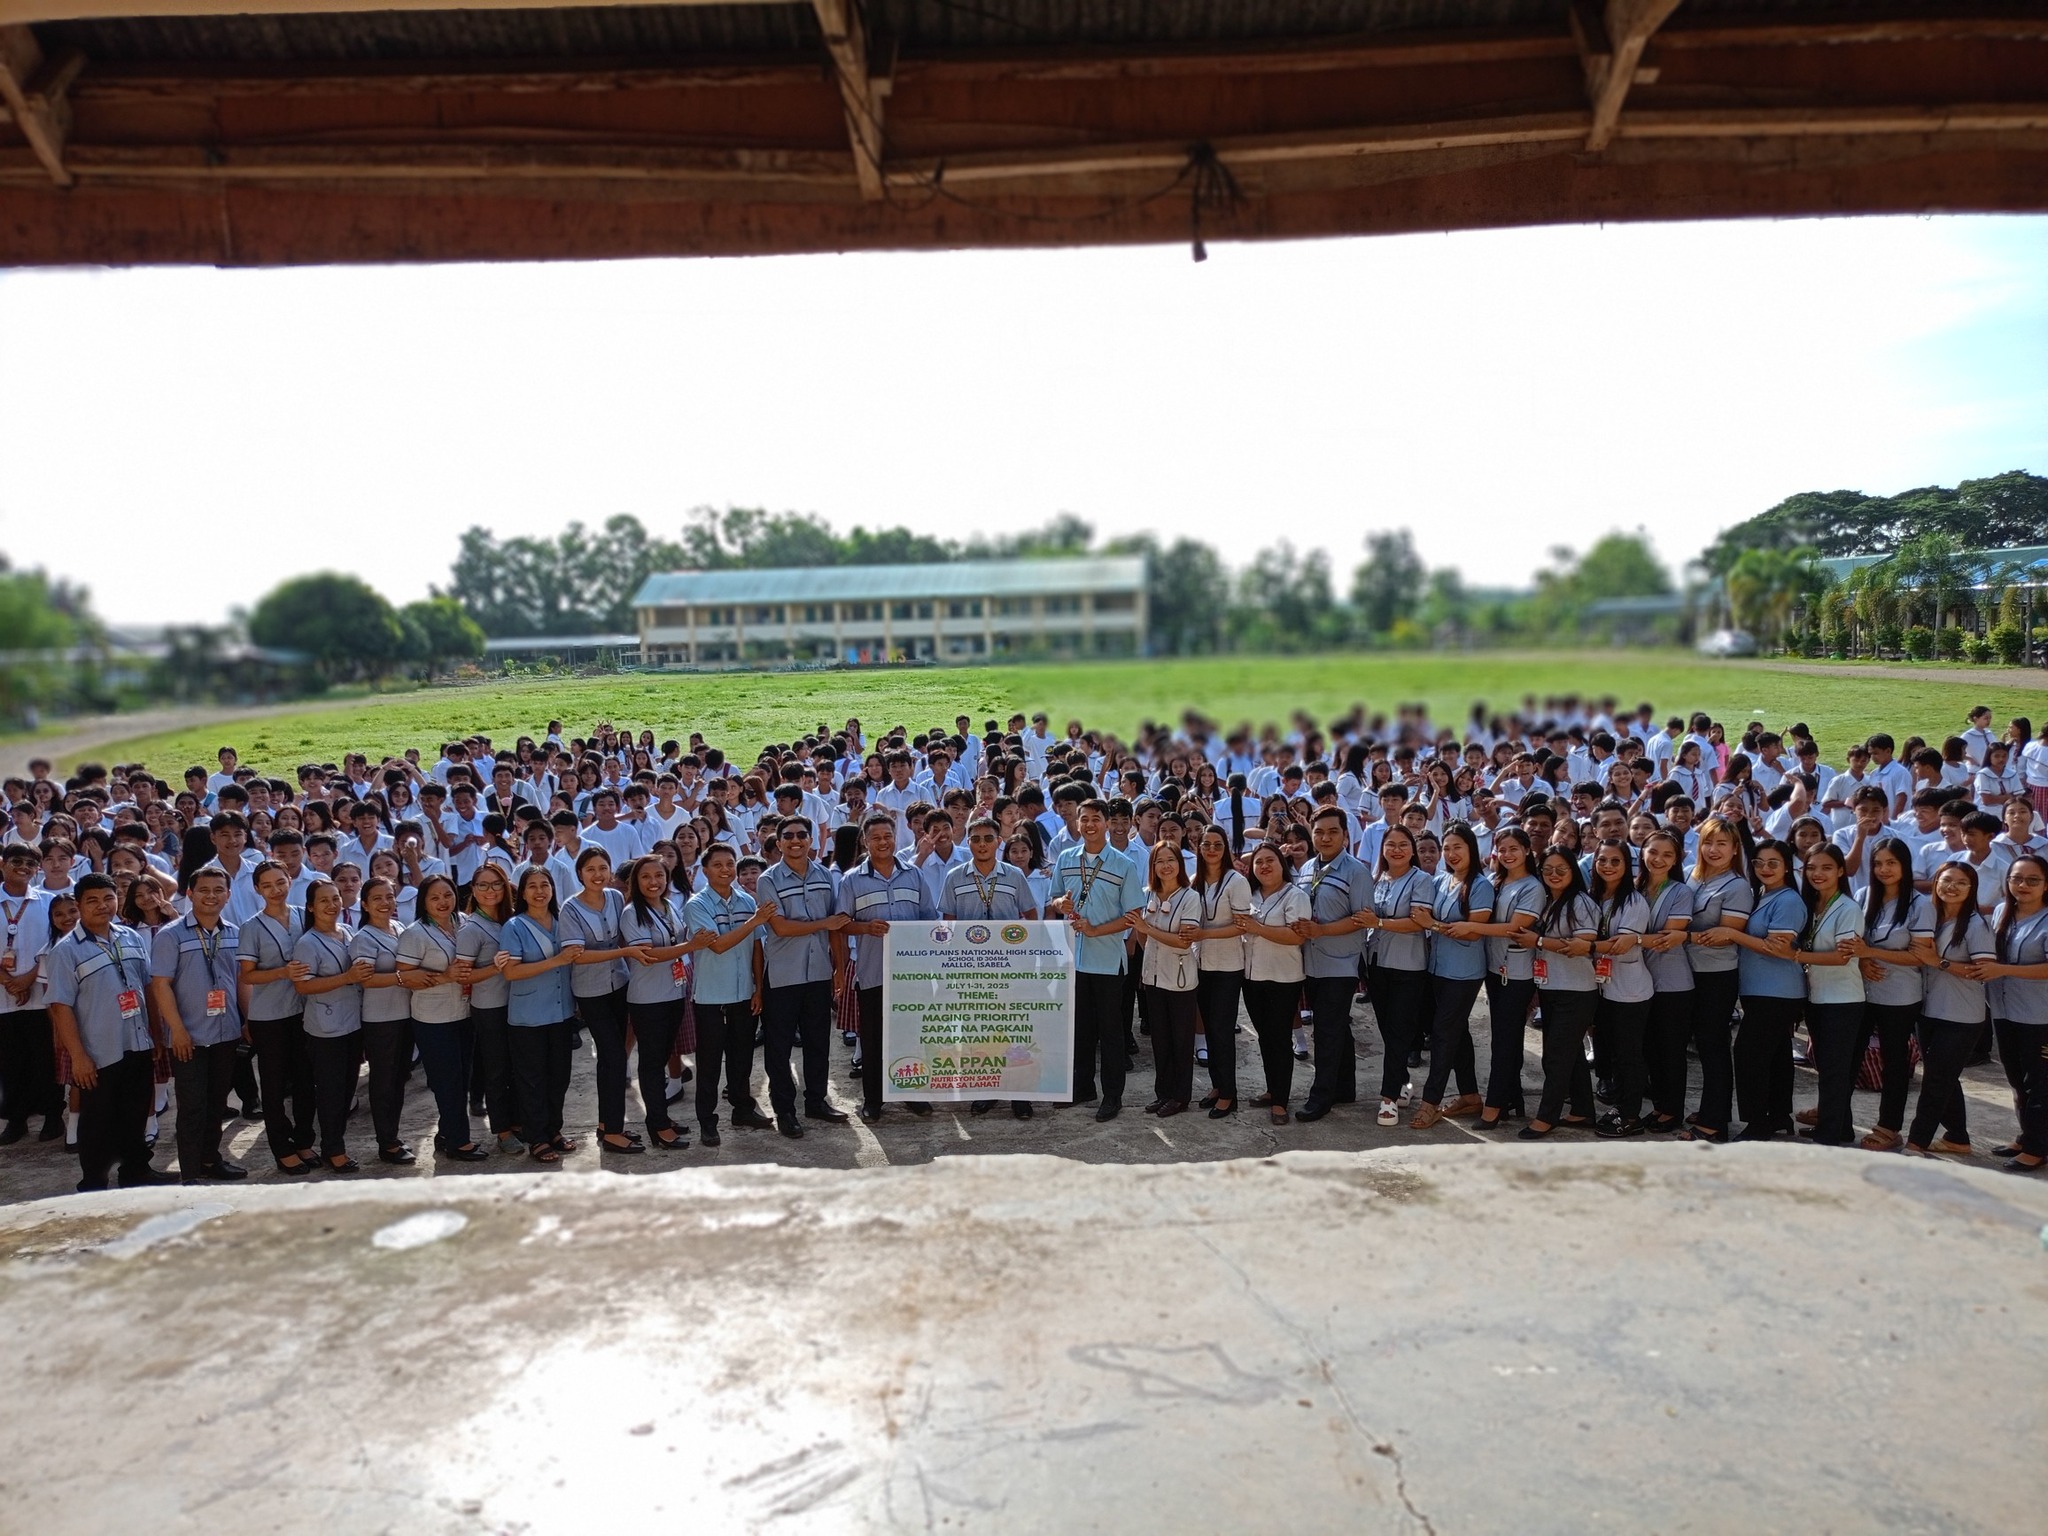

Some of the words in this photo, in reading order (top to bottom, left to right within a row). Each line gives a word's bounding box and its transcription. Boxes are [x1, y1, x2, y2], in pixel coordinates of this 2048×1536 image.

[928, 1003, 943, 1011] AT
[946, 1003, 1006, 1011] NUTRITION
[922, 1014, 971, 1022] MAGING
[922, 1025, 958, 1033] SAPAT
[920, 1036, 989, 1044] KARAPATAN
[932, 1057, 956, 1068] SA
[960, 1056, 1007, 1067] PPAN
[895, 1077, 928, 1086] PPAN
